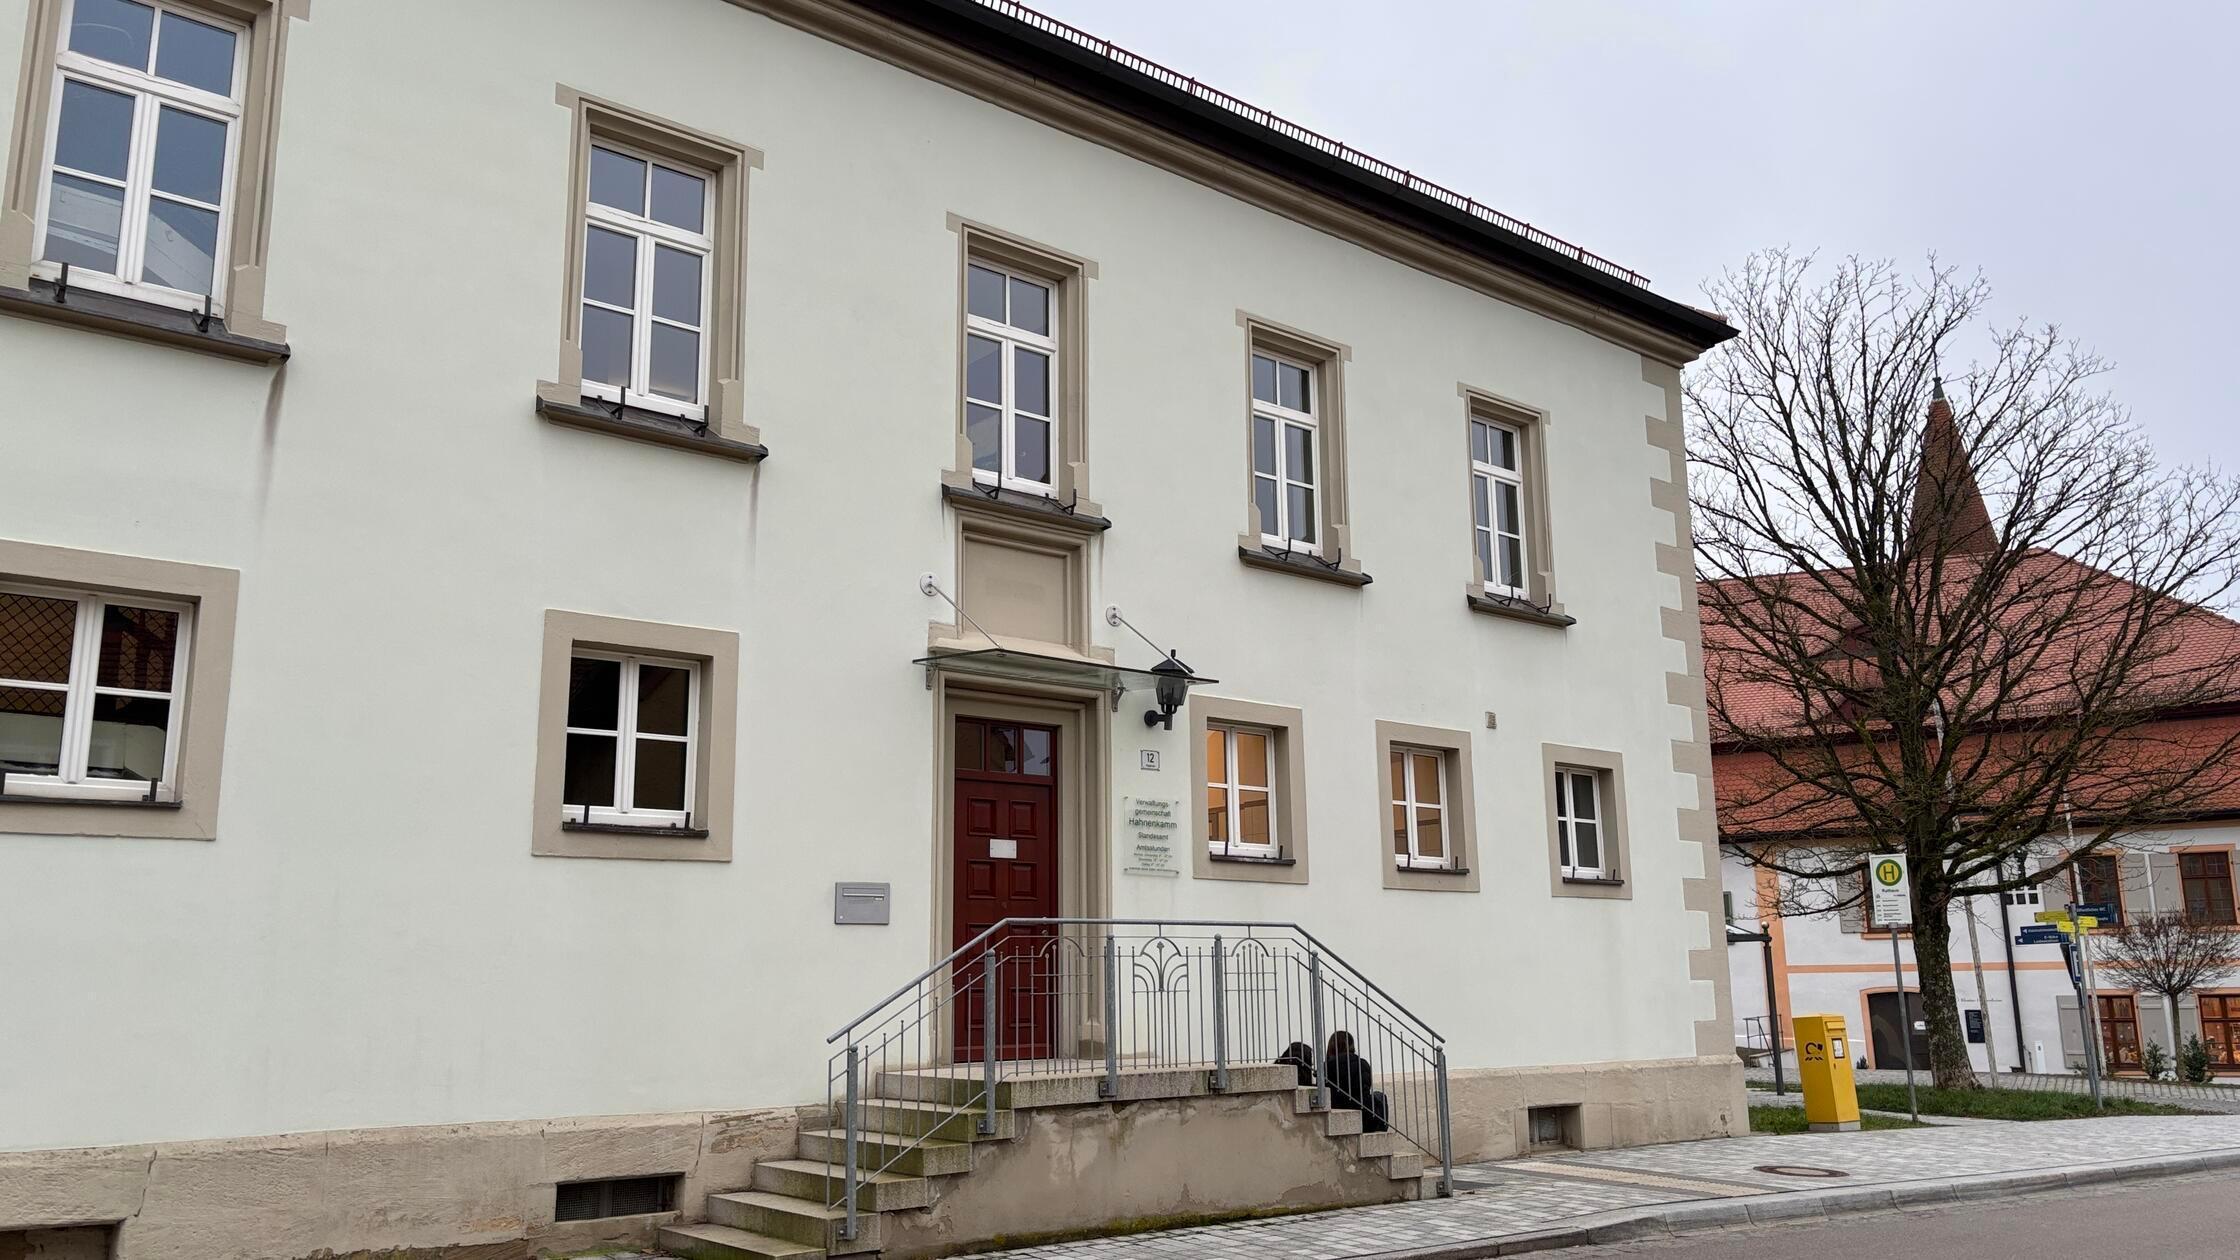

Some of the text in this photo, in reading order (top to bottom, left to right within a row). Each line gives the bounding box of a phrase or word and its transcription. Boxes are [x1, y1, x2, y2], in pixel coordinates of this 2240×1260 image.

[1146, 752, 1155, 763] 12
[1134, 808, 1171, 817] gemeinschaft
[1128, 817, 1178, 829] Hahnenkamm
[1137, 831, 1169, 840] Standesamt
[1883, 865, 1895, 880] H
